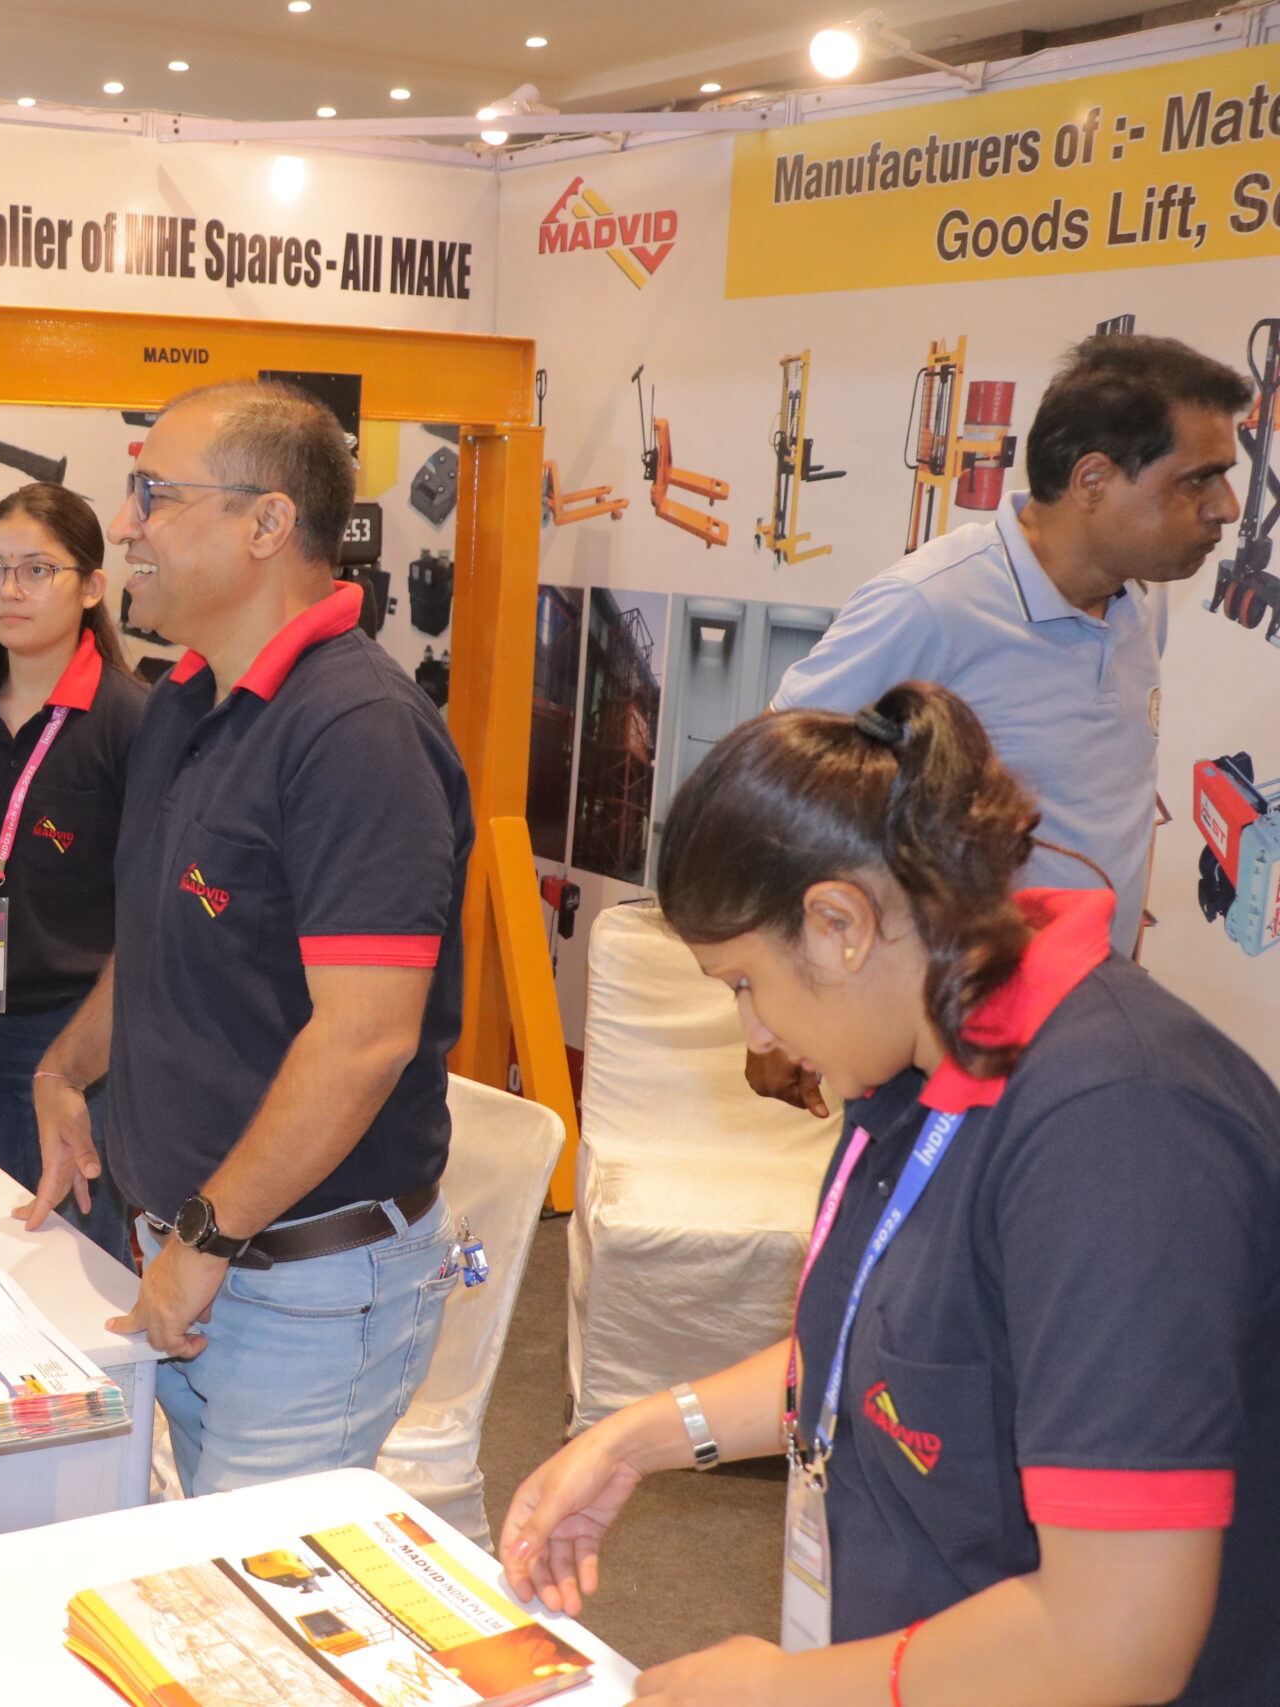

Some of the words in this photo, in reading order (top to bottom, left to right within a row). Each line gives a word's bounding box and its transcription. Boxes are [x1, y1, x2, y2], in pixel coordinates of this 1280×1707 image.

[773, 130, 1039, 204] Manufacturers
[1053, 109, 1101, 168] of
[538, 209, 678, 255] MADVID
[936, 199, 1090, 262] Goods
[1108, 184, 1207, 249] Lift,
[81, 211, 117, 274] of
[124, 212, 196, 279] MHE
[390, 236, 472, 300] MAKE
[143, 347, 209, 364] MADVID
[399, 1544, 446, 1584] MADVID
